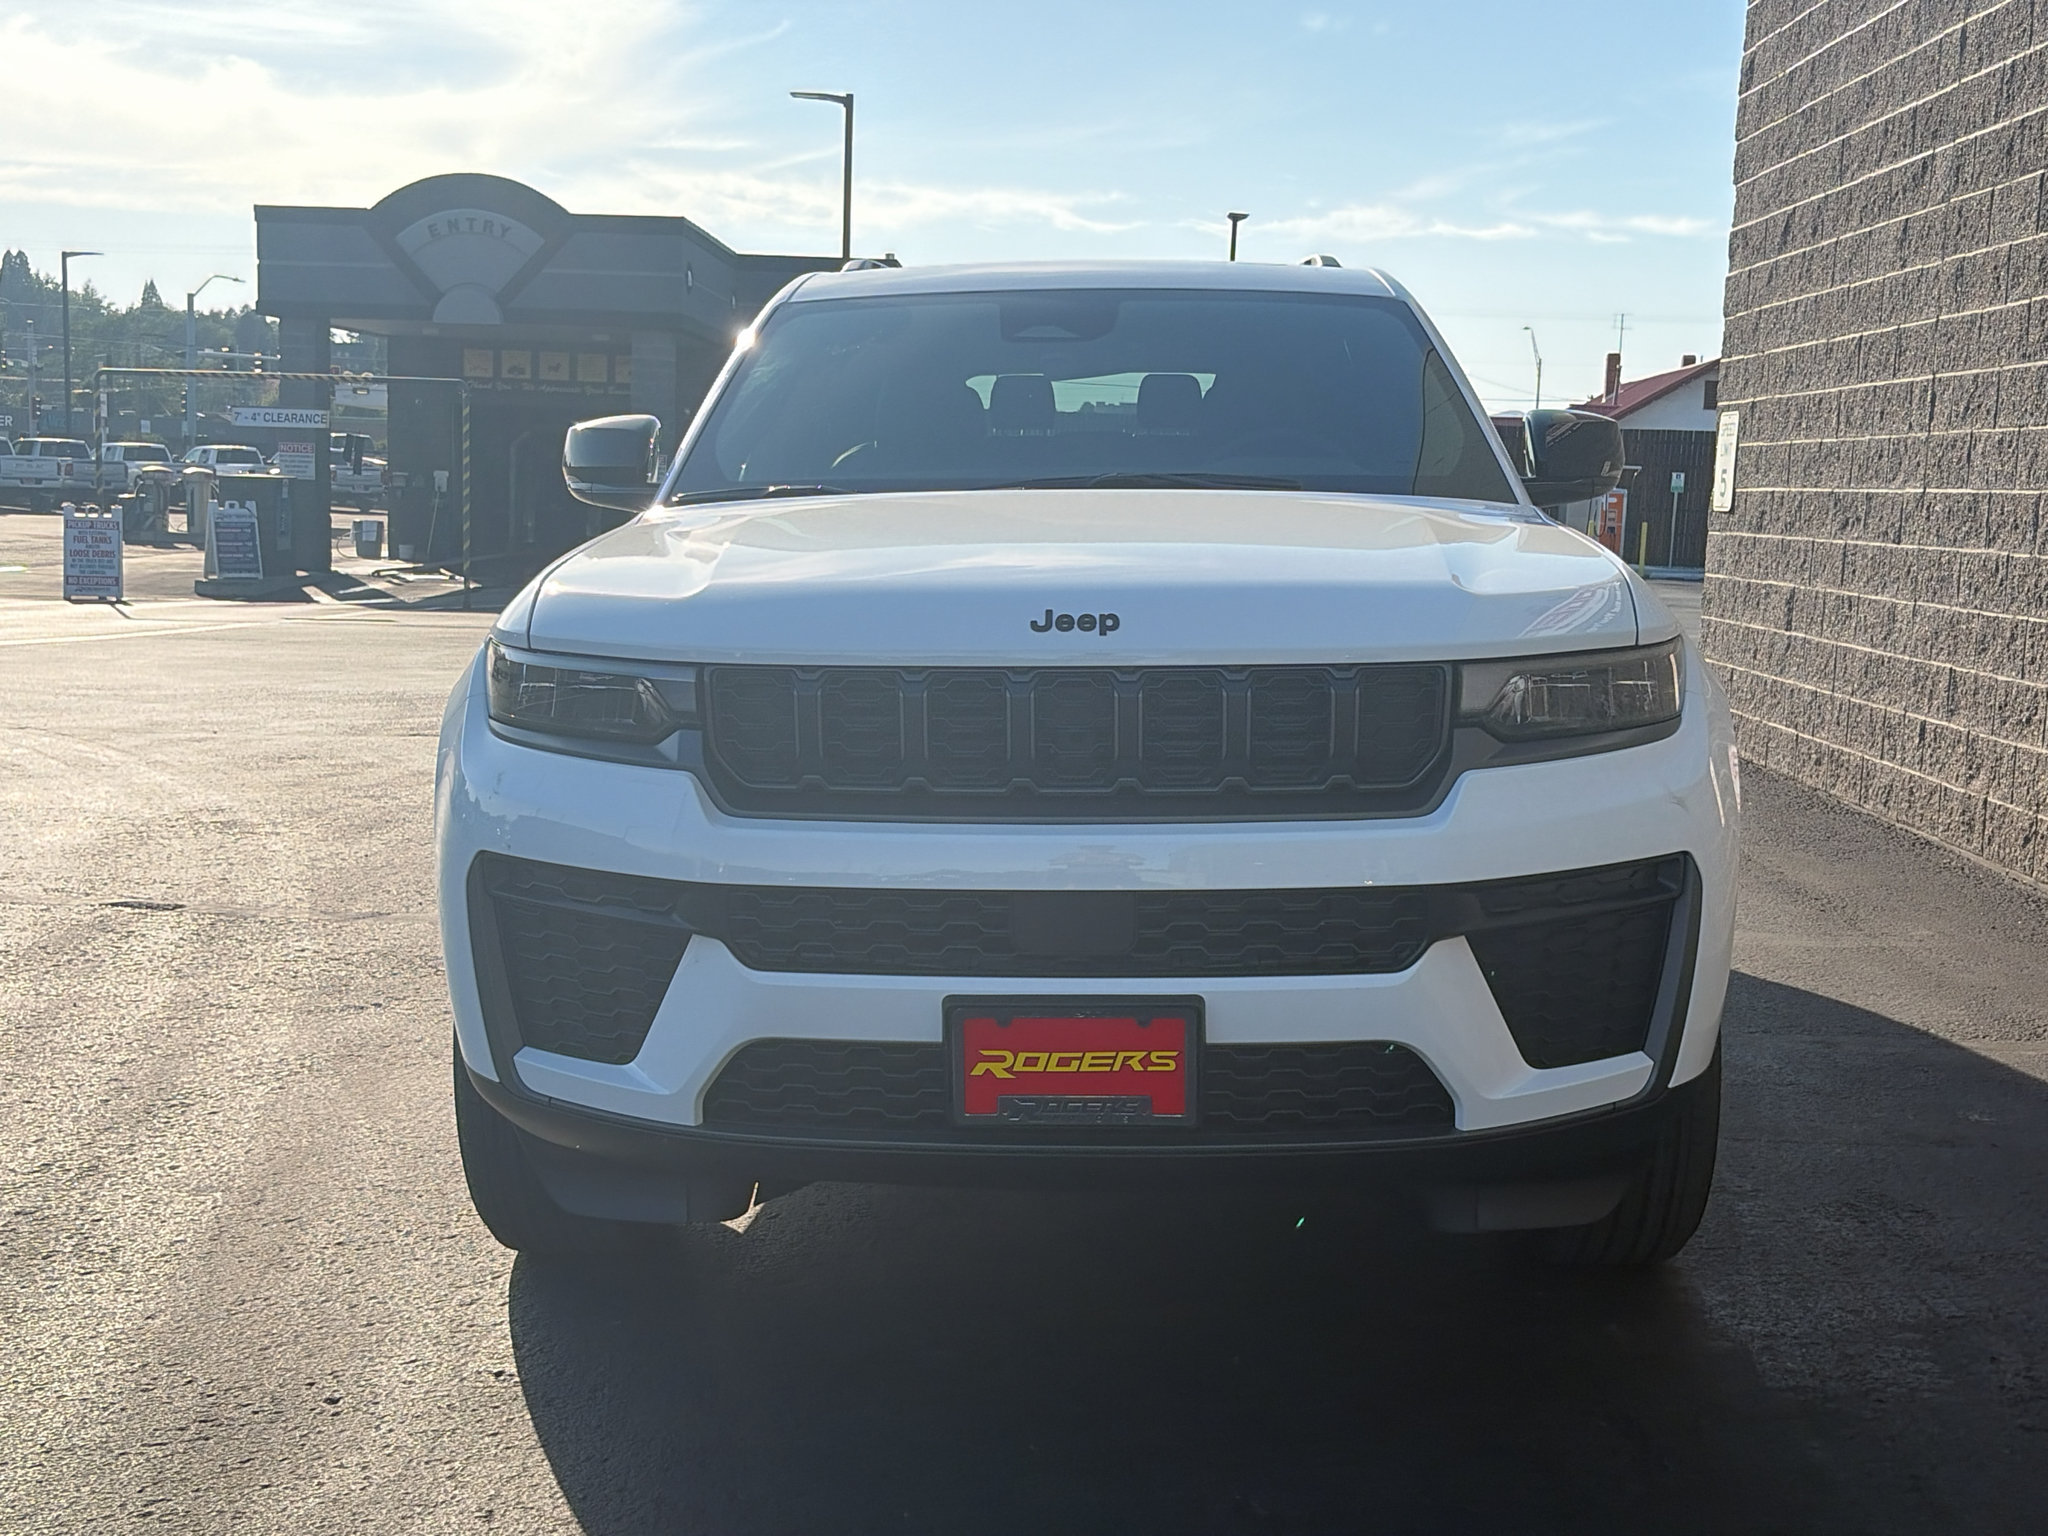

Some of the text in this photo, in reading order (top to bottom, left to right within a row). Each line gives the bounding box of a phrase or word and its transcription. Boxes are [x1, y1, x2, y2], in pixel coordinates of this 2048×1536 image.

[427, 217, 512, 239] ENTRY
[263, 412, 328, 424] CLEARANCE
[280, 443, 313, 453] NOTICE
[1719, 468, 1728, 498] 5
[67, 520, 118, 530] PICKUP TRUCKS
[73, 535, 112, 544] FUEL TANKS
[69, 549, 116, 558] LOOSE DEBRIS
[67, 576, 116, 586] NO EXCEPTIONS
[1030, 609, 1120, 636] Jeep
[970, 1050, 1180, 1079] ROGERS
[1007, 1099, 1140, 1121] ROGERS
